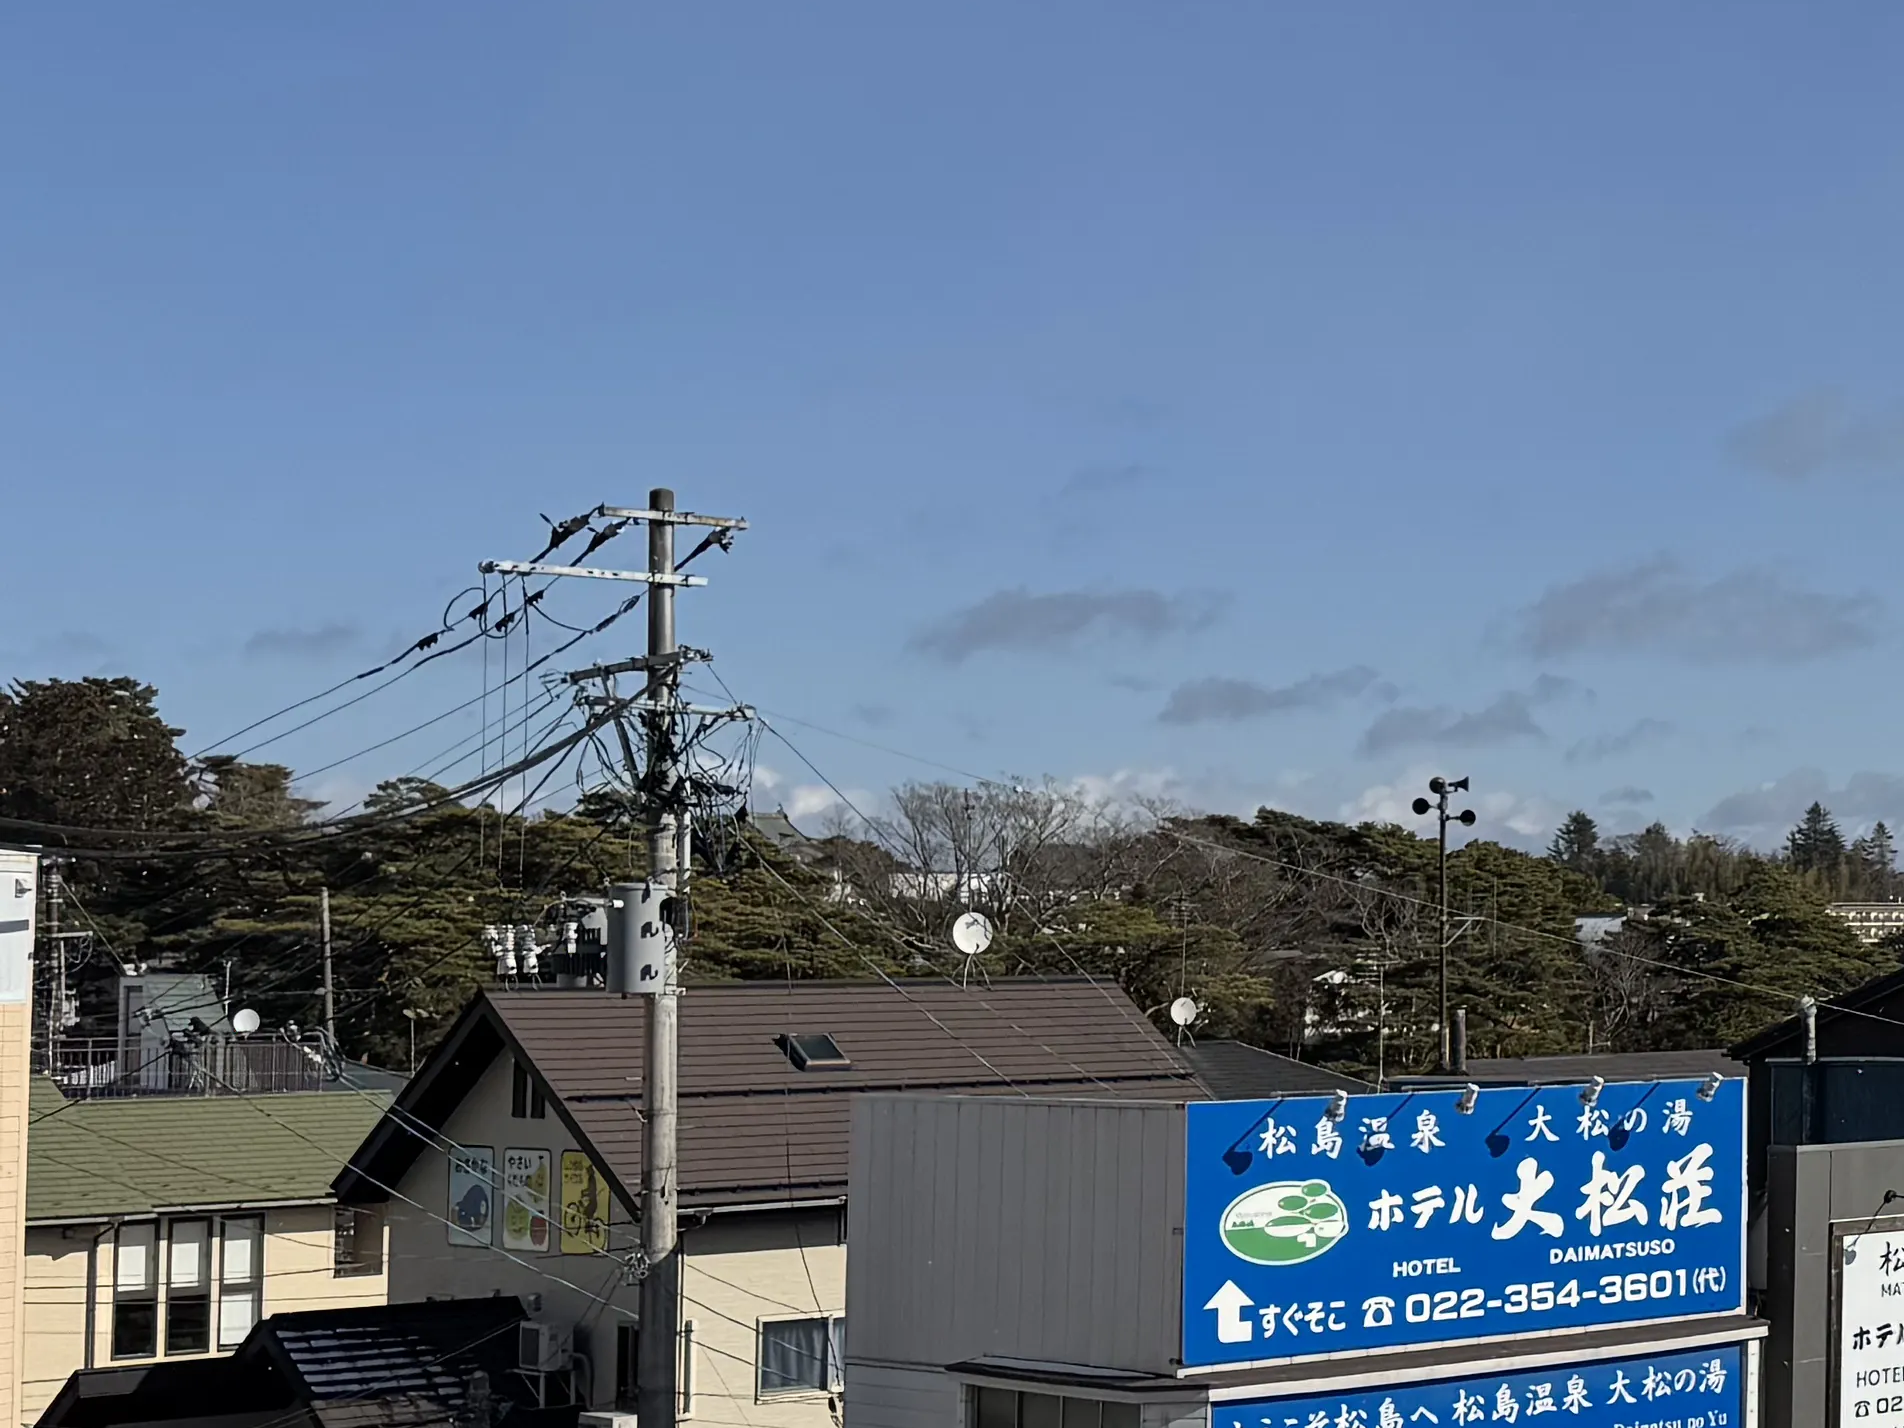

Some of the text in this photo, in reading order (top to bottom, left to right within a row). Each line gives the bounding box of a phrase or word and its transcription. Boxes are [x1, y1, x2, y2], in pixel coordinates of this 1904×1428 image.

[1259, 1099, 1693, 1158] 松島温泉 大松の湯
[1367, 1142, 1723, 1240] ホテル 大松荘
[1392, 1238, 1675, 1277] HOTEL DAIMATSUSO
[1259, 1299, 1346, 1339] すぐそこ
[1452, 1375, 1594, 1425] 松島温泉
[1605, 1358, 1727, 1406] 大松の湯
[1708, 1410, 1728, 1428] Yu
